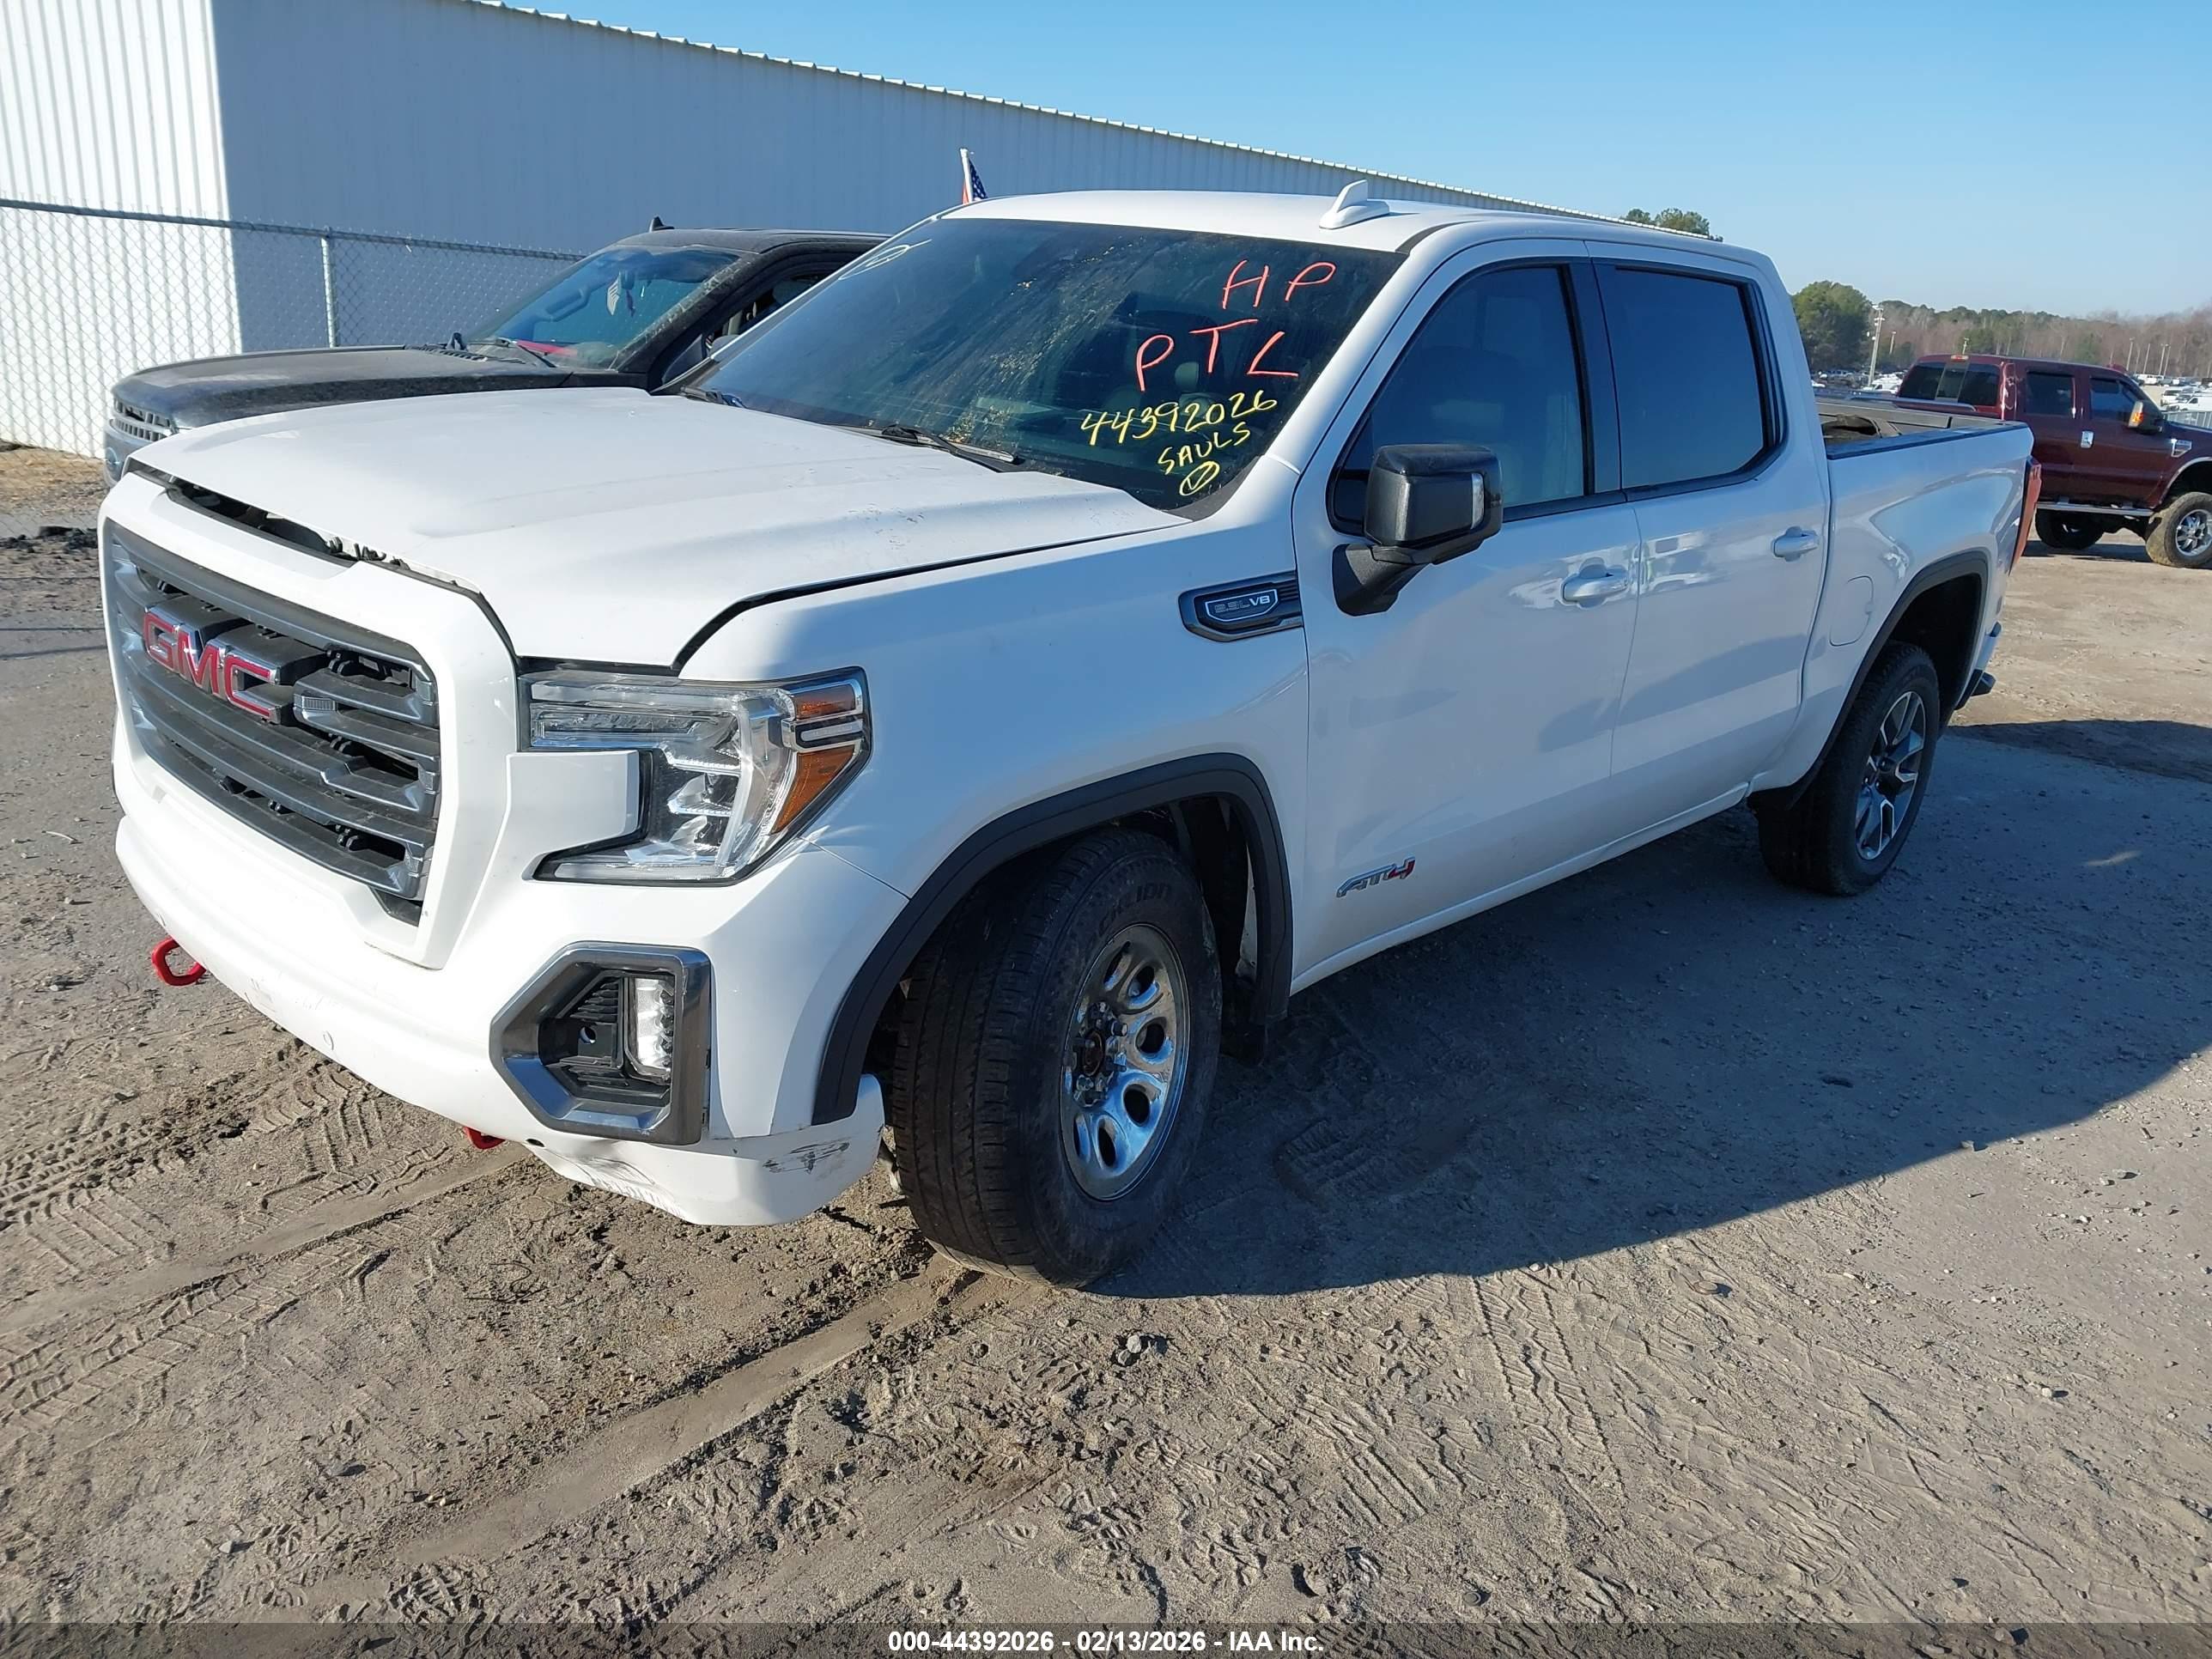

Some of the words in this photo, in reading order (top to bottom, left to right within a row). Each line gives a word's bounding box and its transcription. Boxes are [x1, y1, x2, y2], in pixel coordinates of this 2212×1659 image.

[1136, 319, 1299, 392] PTL
[1079, 390, 1278, 447] 44392026
[1158, 421, 1251, 476] SAULS
[1249, 595, 1271, 606] V8
[143, 606, 282, 726] GMC
[1336, 855, 1416, 898] AT4
